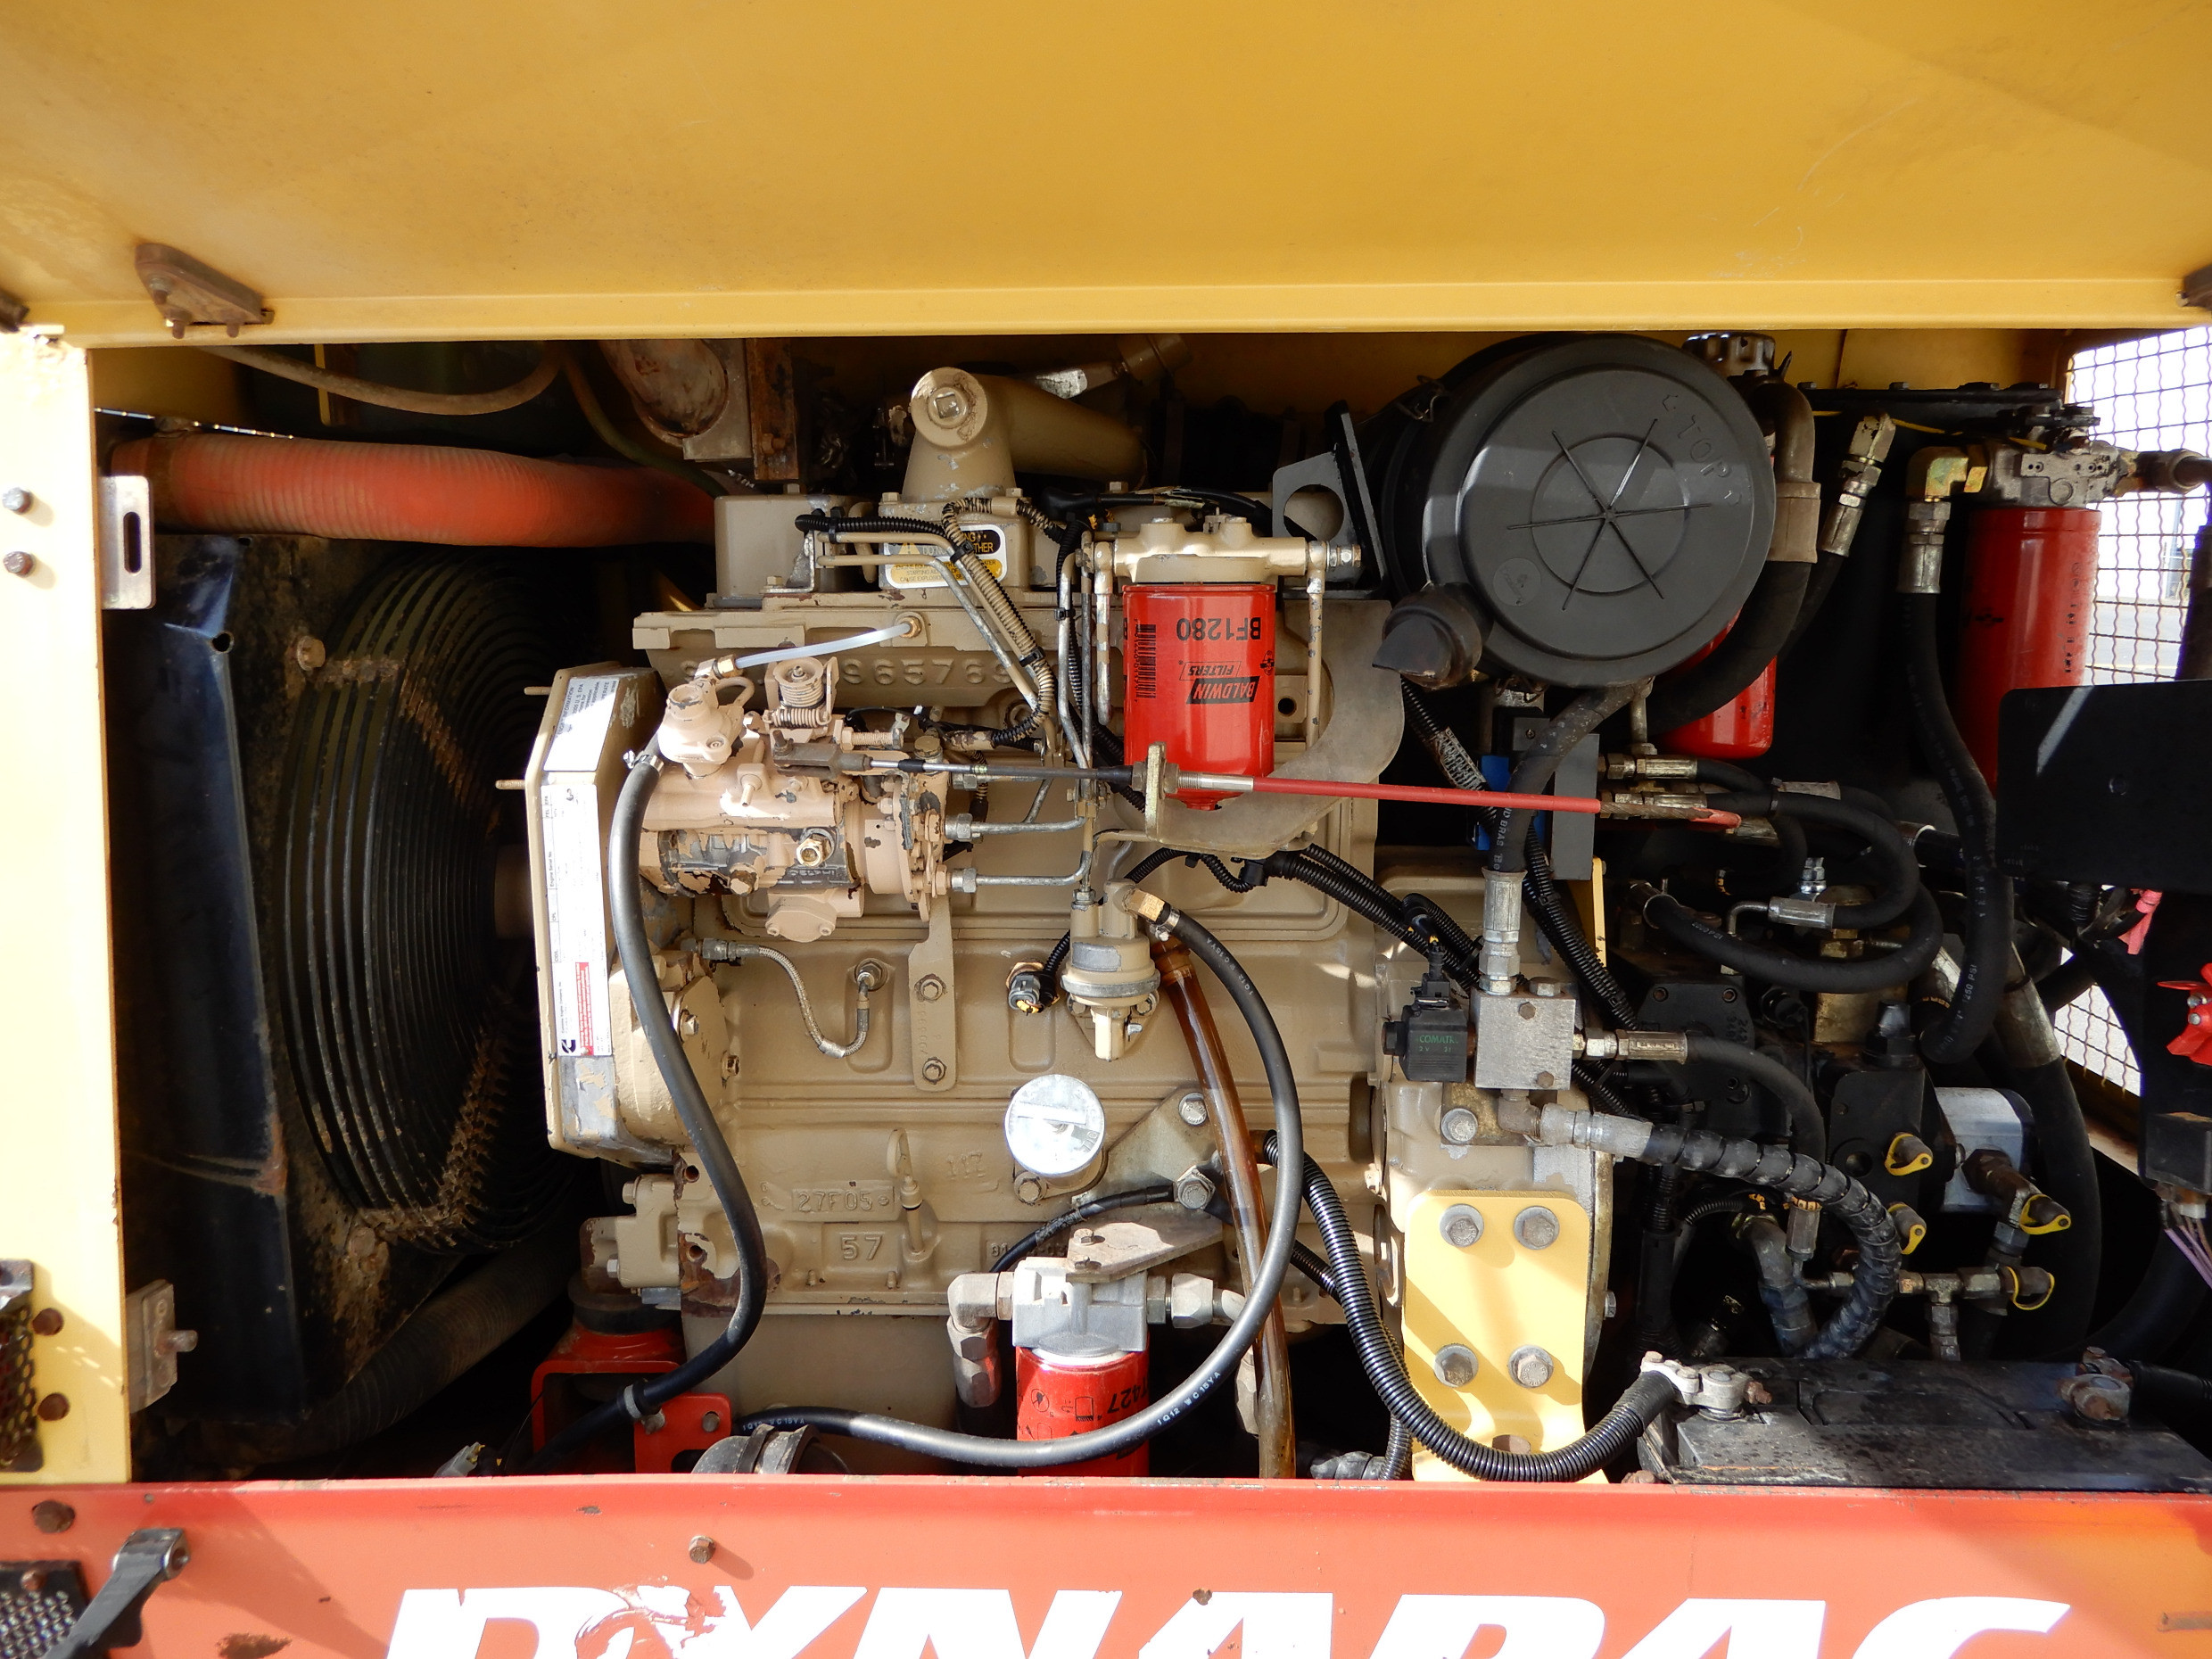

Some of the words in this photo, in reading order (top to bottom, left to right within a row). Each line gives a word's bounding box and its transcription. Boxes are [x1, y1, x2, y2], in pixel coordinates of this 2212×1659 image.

[972, 542, 994, 554] THER
[1176, 616, 1261, 640] BF1280
[1187, 664, 1234, 676] FILTERS
[1193, 681, 1257, 700] BALDWIN
[1968, 964, 1977, 981] PSI
[841, 1234, 885, 1260] 57
